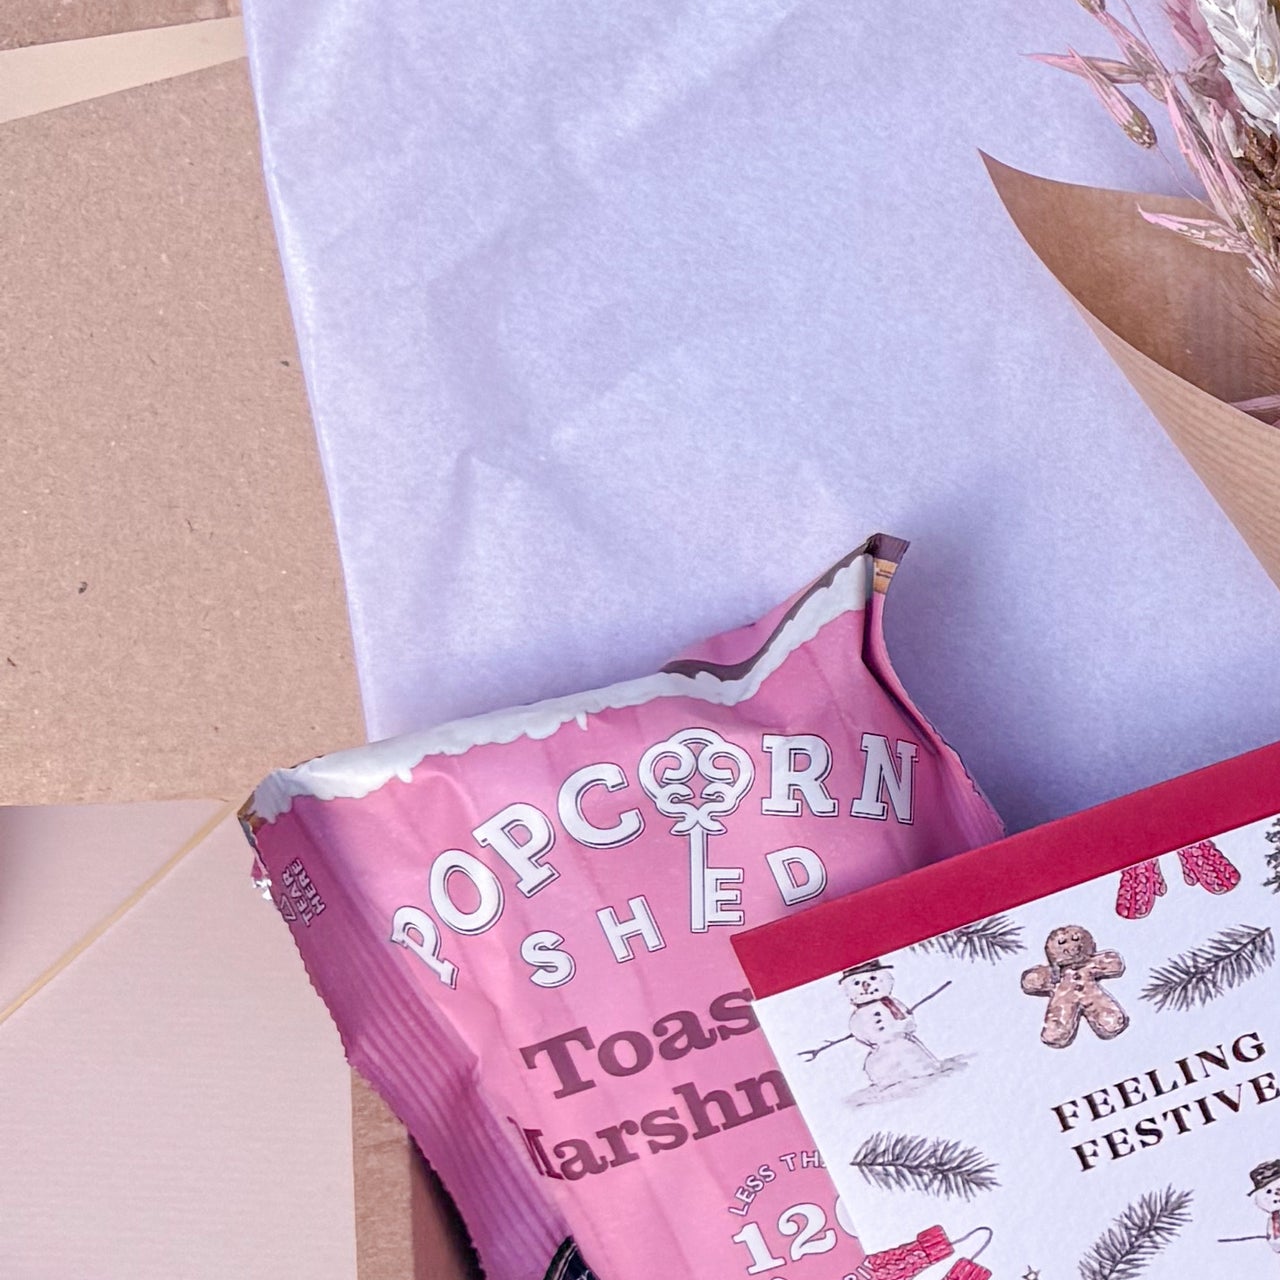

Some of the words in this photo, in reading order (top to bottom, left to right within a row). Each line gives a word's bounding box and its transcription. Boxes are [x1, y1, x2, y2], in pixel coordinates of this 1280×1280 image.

[282, 865, 315, 928] TEAR
[291, 857, 326, 915] HERE
[391, 727, 919, 990] POPCORN
[520, 846, 828, 989] SHED
[1050, 1031, 1266, 1133] FEELING
[728, 1164, 776, 1217] LESS
[779, 1150, 827, 1171] TH
